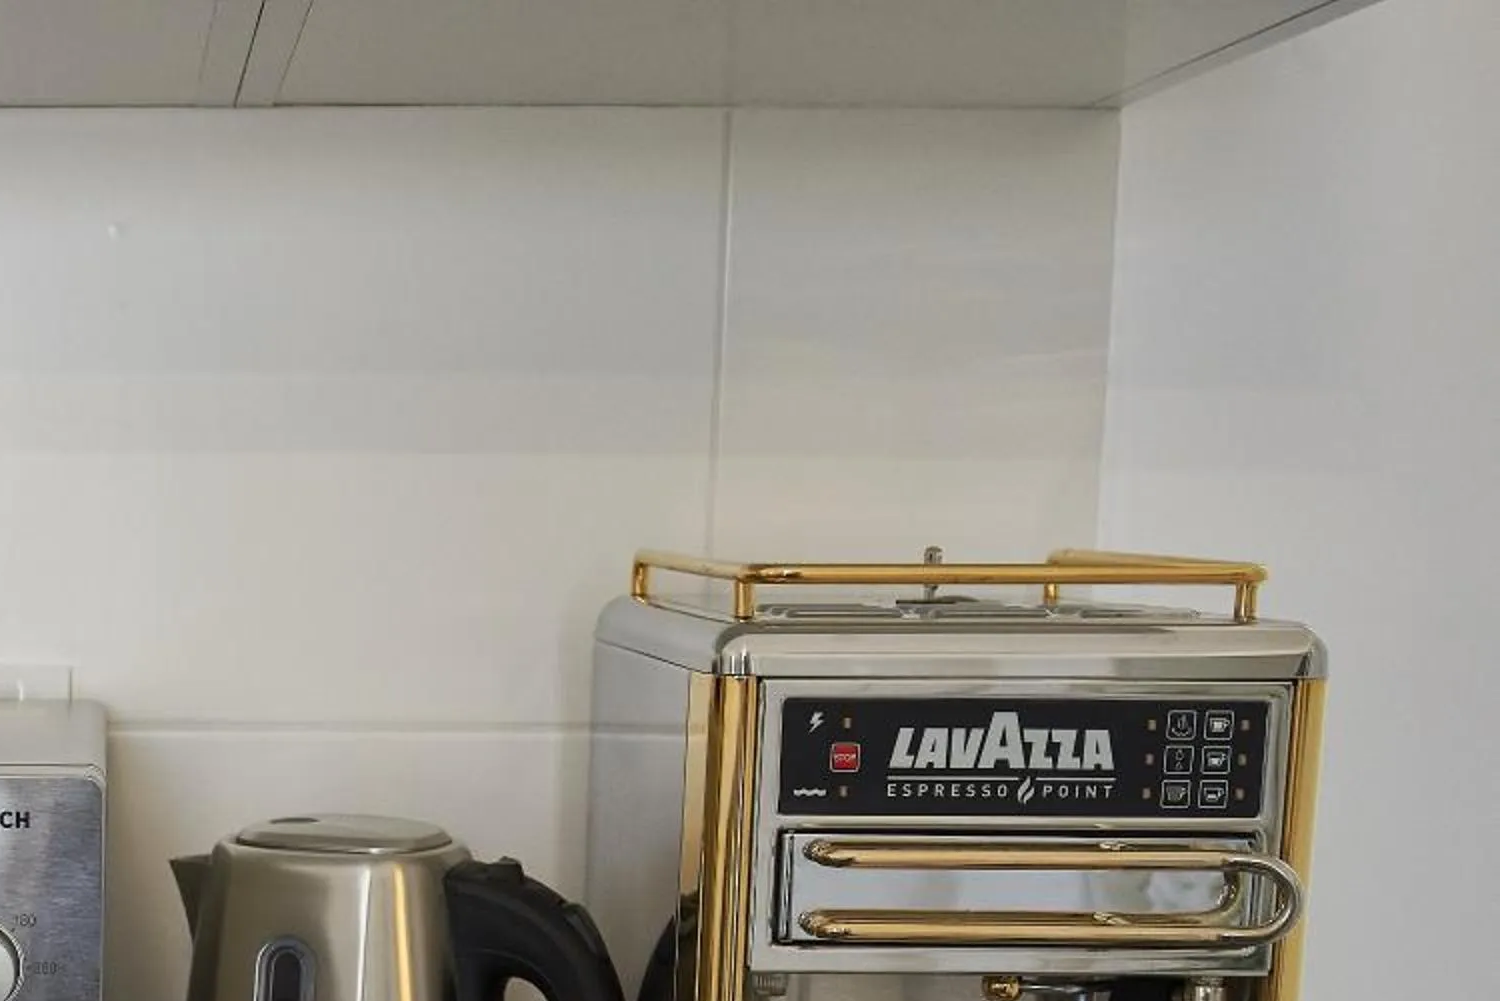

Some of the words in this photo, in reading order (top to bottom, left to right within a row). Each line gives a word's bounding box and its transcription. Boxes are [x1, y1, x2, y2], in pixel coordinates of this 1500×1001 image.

[889, 711, 1114, 769] LAVAZZA
[887, 784, 1007, 797] ESPRESSO
[1042, 785, 1114, 798] POINT
